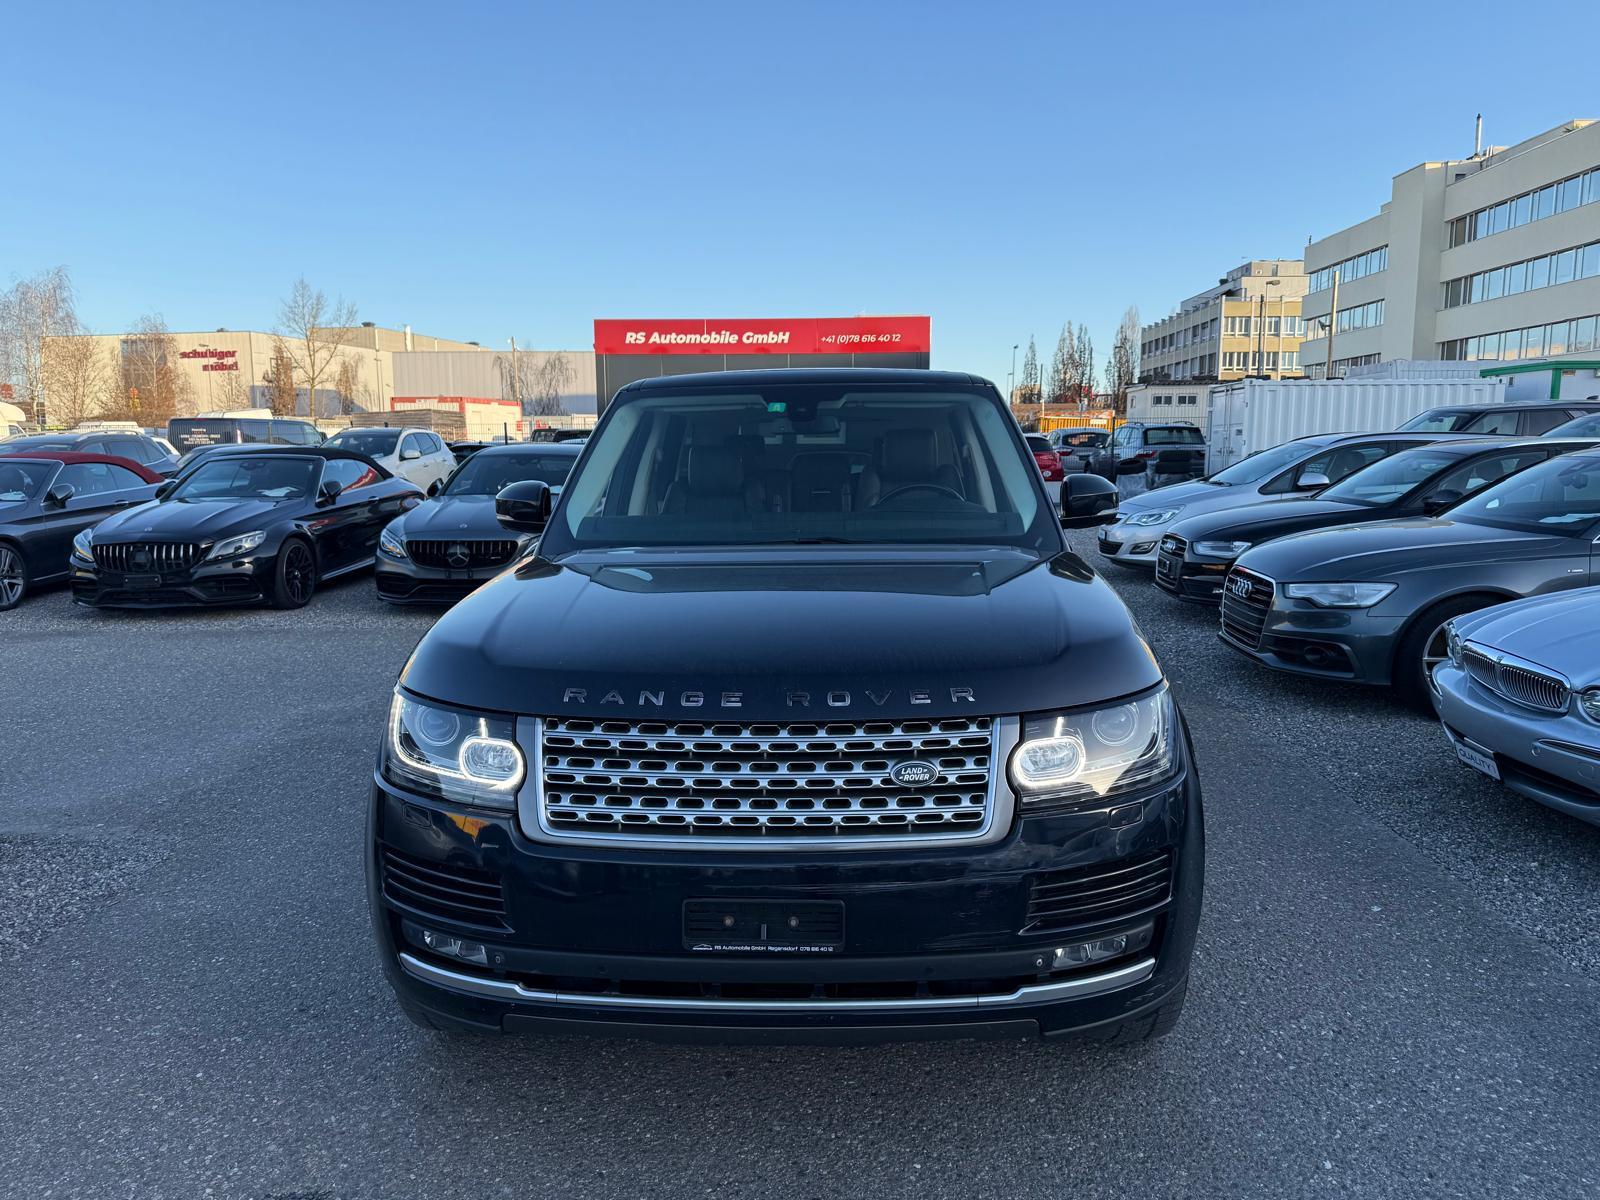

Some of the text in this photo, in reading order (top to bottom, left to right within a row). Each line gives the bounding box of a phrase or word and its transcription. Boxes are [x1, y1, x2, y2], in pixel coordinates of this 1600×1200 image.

[625, 331, 790, 344] RS Automobile GmbH
[821, 334, 901, 344] +41 (0)78 616 40 12
[179, 348, 237, 360] schubiger
[562, 687, 976, 707] RANGE ROVER
[903, 773, 930, 781] ROVER
